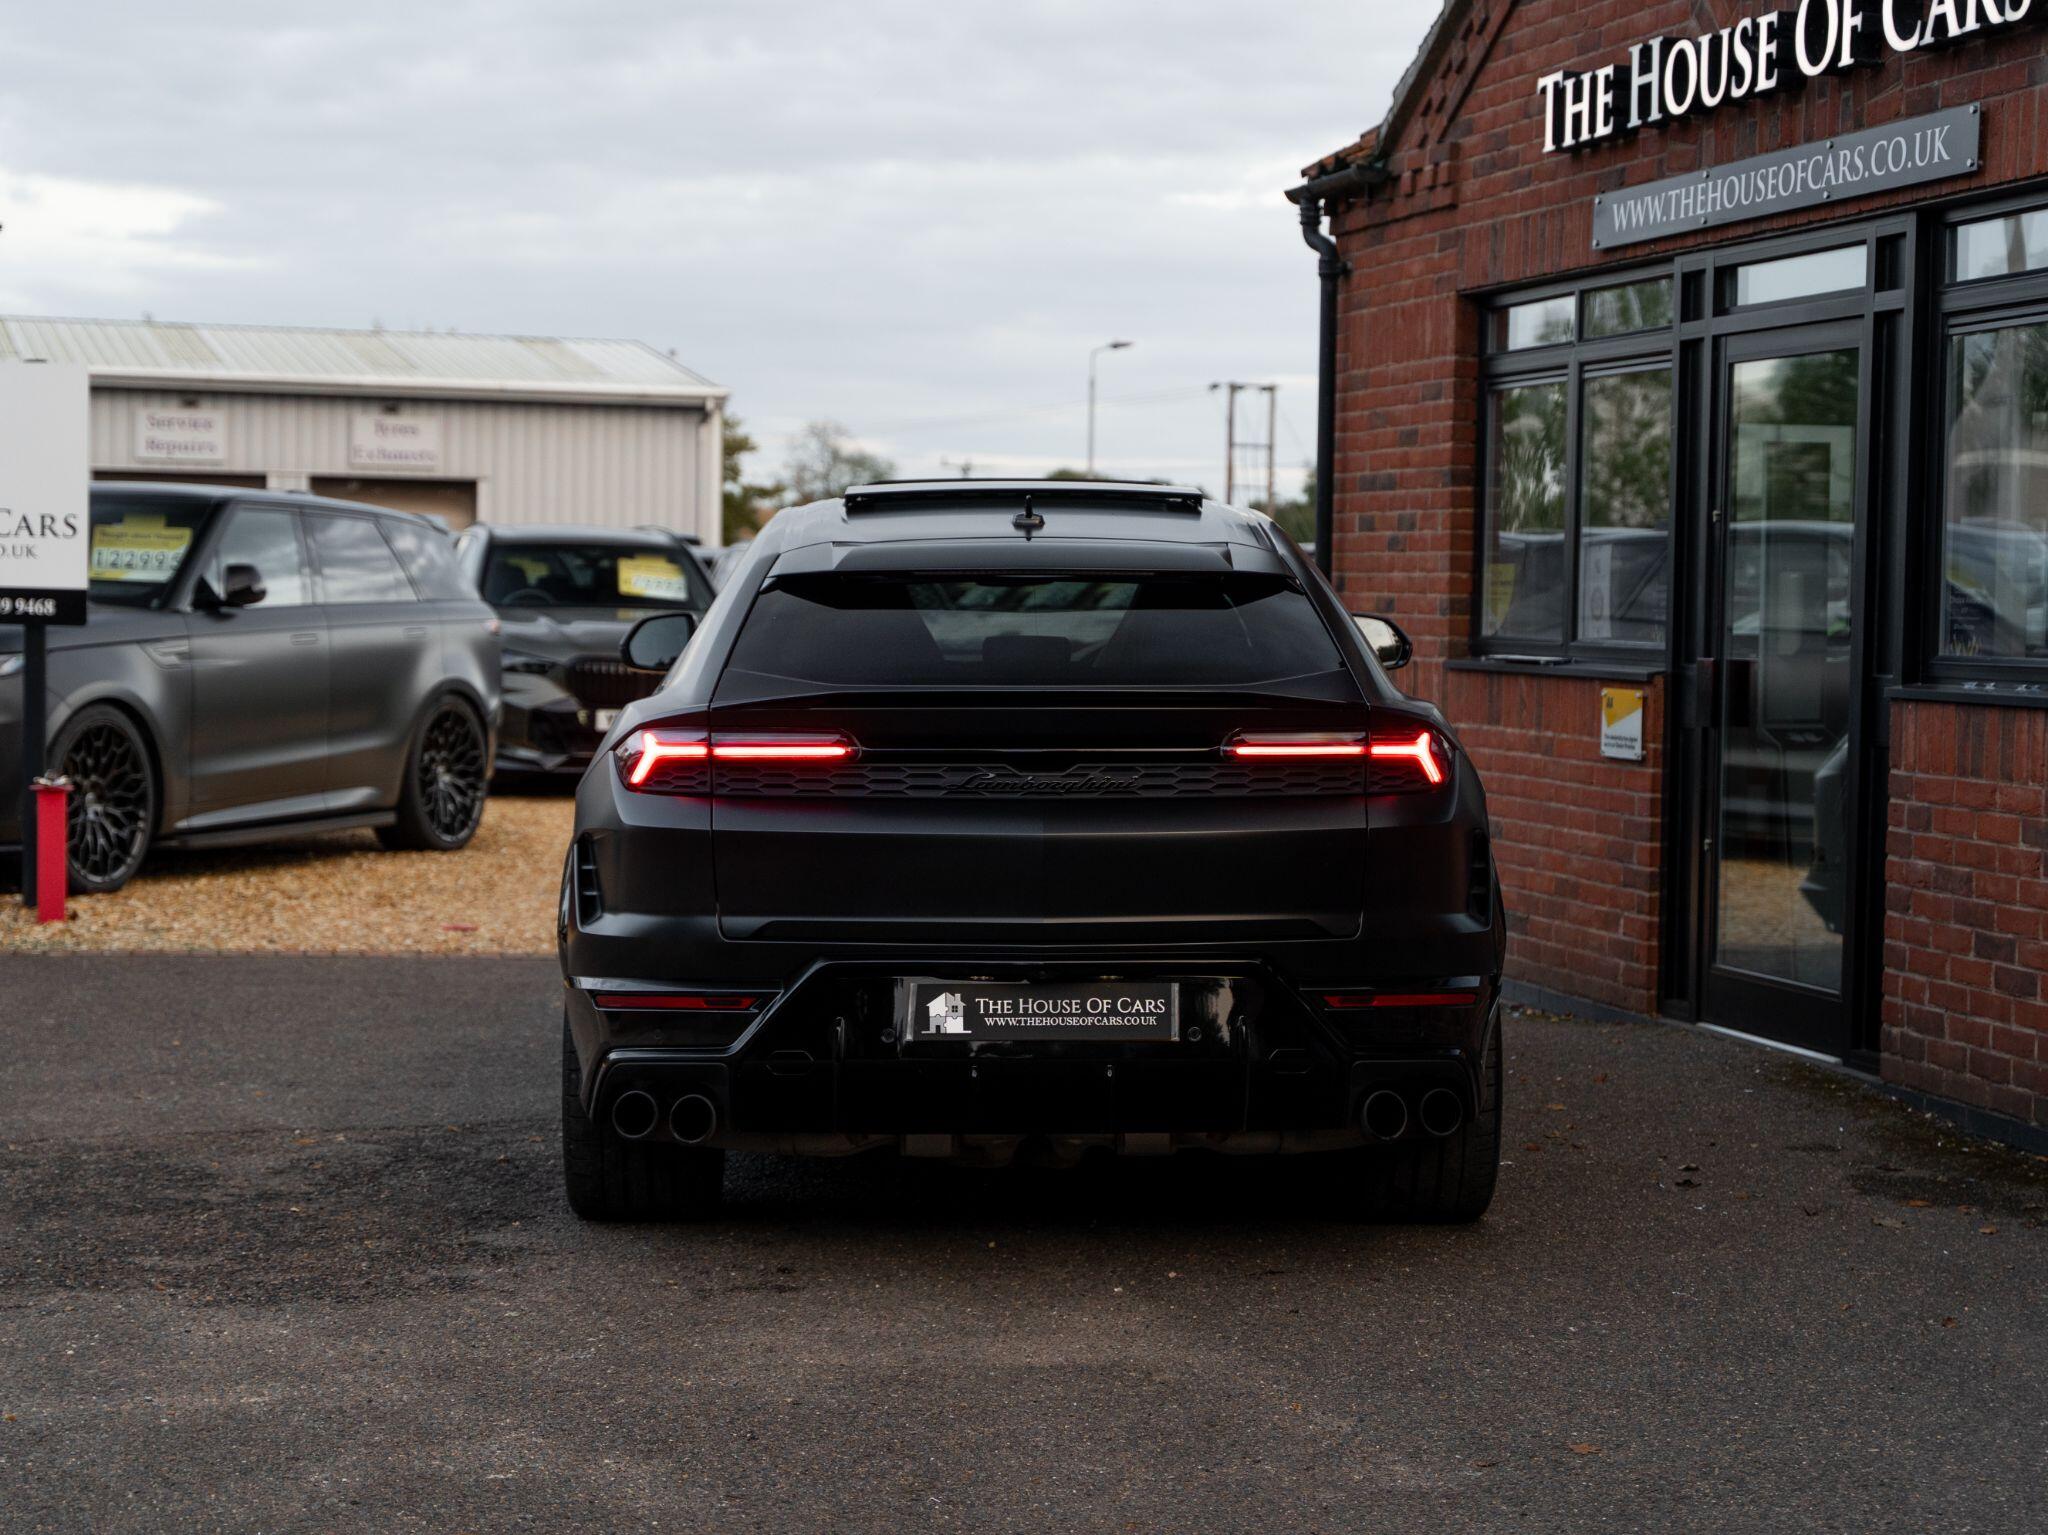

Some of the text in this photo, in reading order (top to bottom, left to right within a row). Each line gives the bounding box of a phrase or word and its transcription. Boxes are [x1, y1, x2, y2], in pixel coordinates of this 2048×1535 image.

[1537, 63, 1614, 153] THE
[1626, 10, 1778, 129] HOUSE
[1795, 0, 1862, 76] OF
[1612, 124, 1951, 233] WWW.THEHOUSEOFCARS.CO.UK
[975, 997, 1166, 1014] THE HOUSE OF CARS
[984, 1016, 1158, 1027] WWW.THEHOUSEOFCARS.COUK
